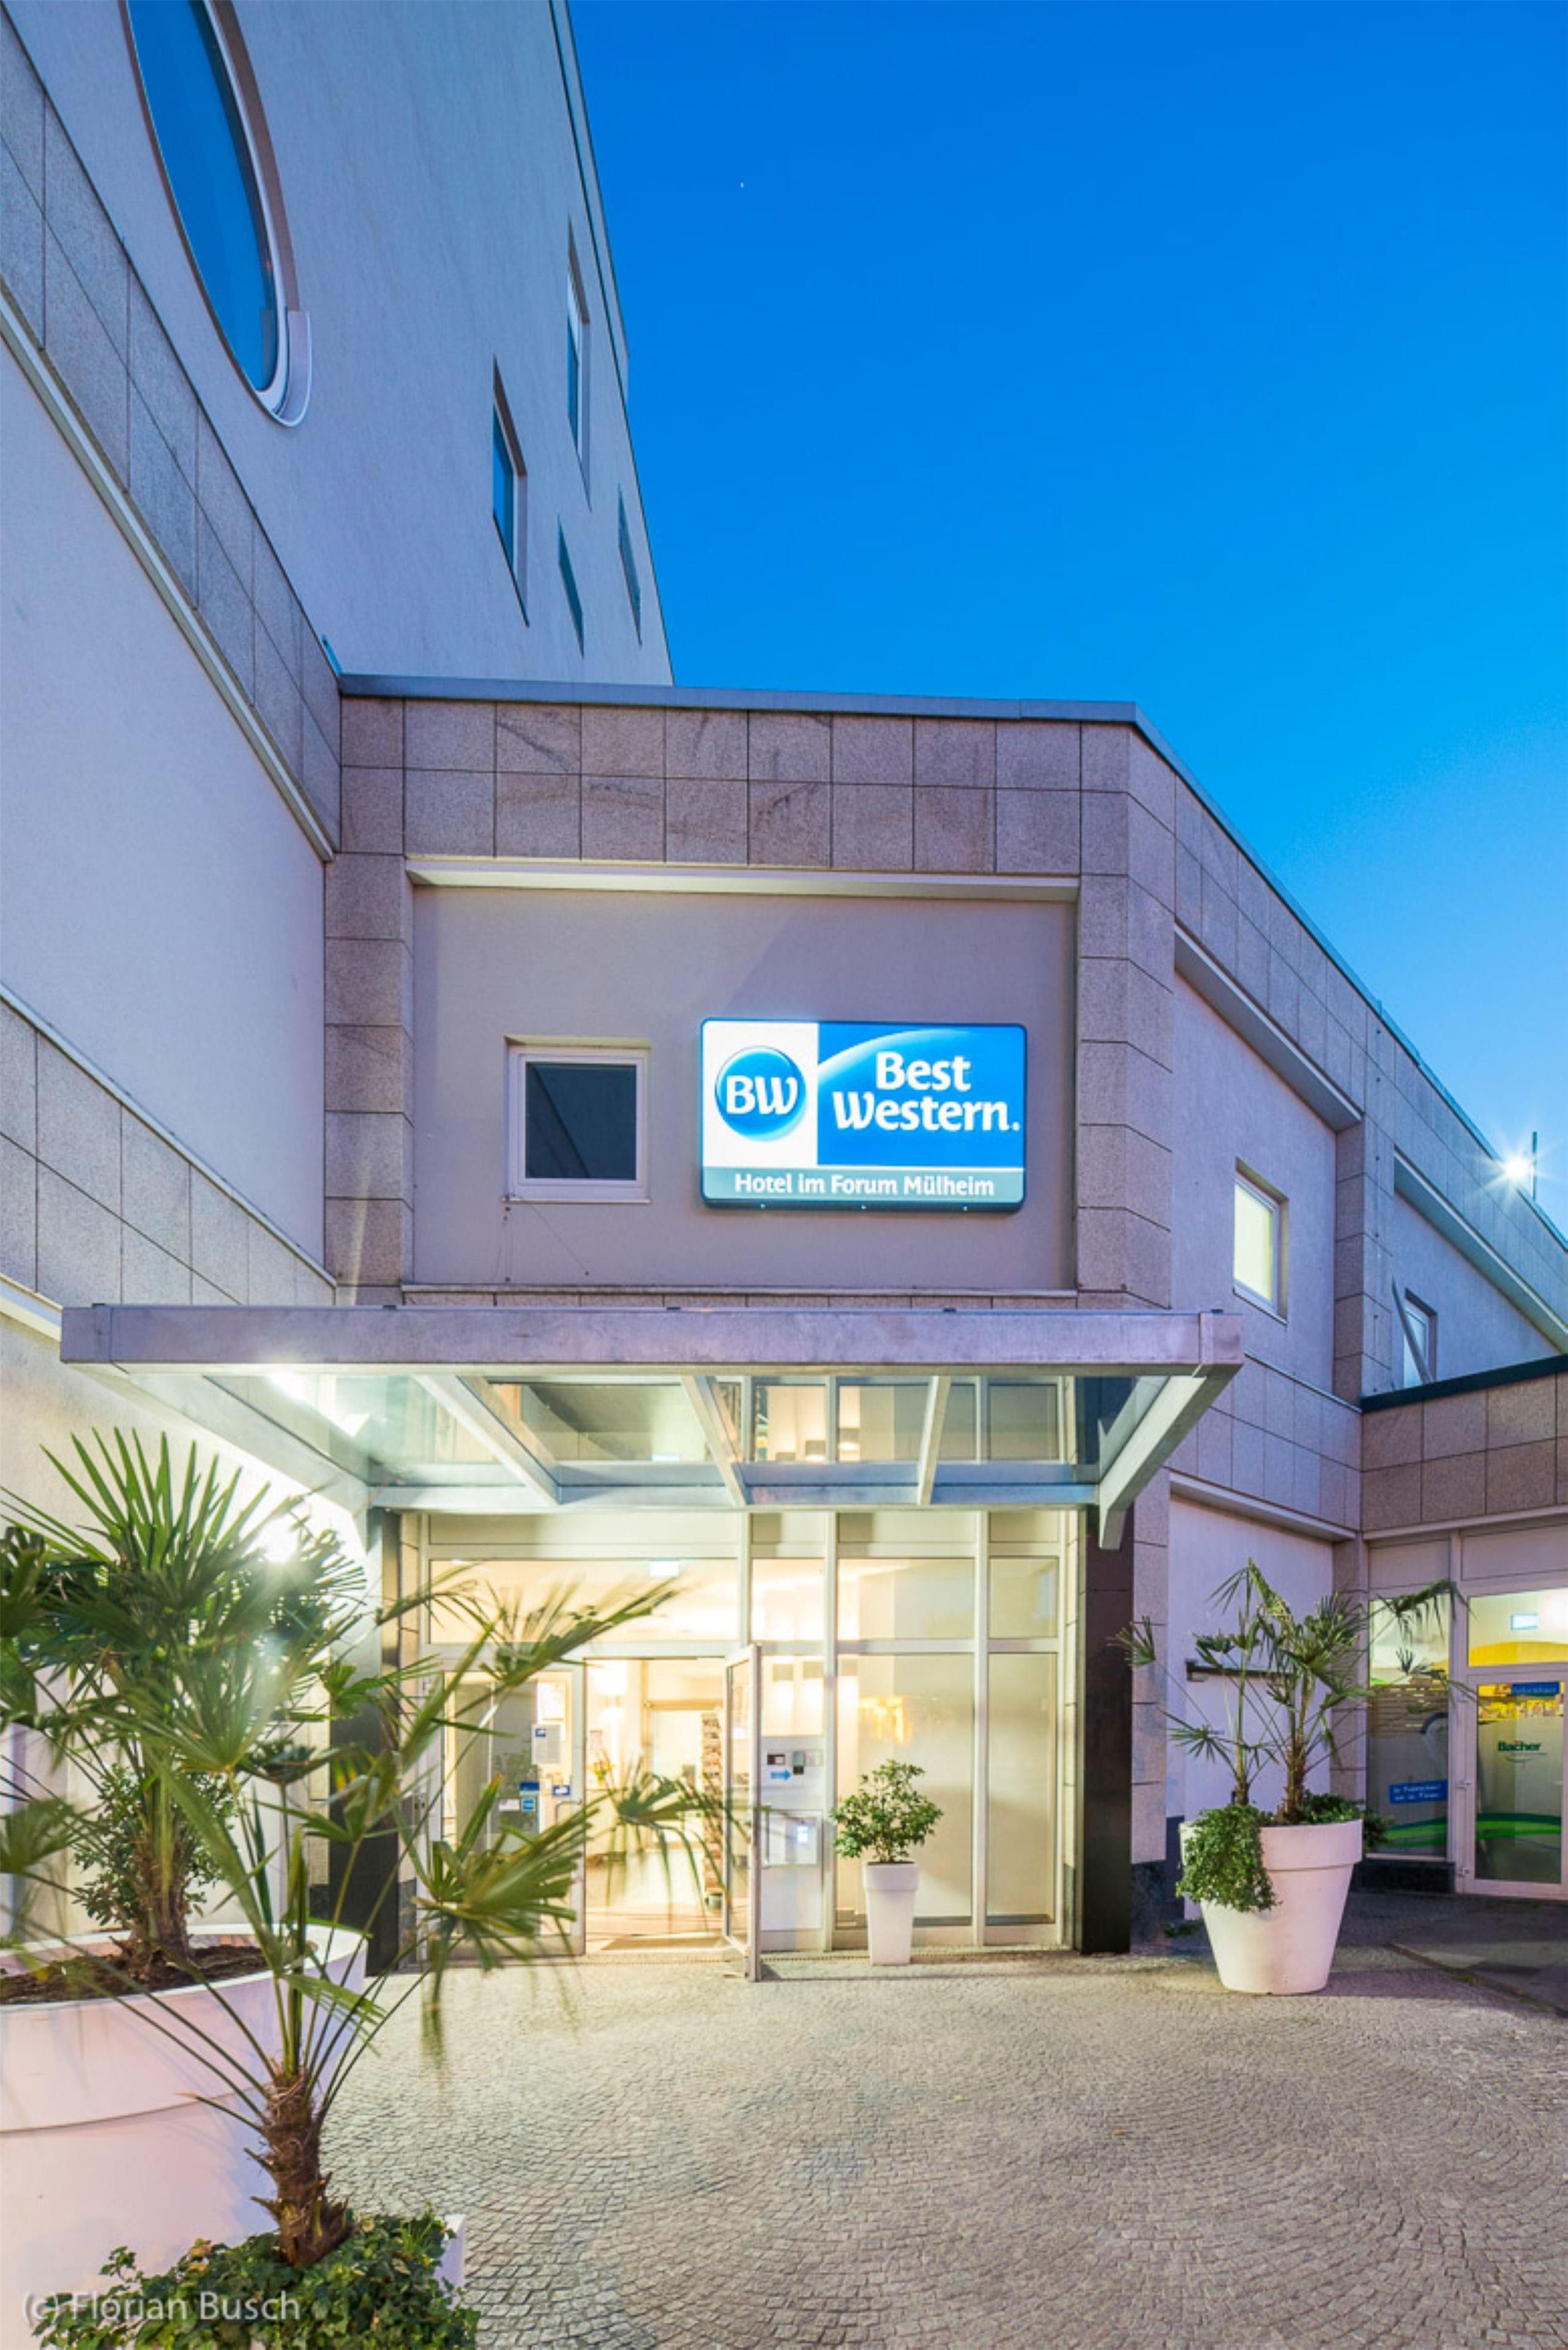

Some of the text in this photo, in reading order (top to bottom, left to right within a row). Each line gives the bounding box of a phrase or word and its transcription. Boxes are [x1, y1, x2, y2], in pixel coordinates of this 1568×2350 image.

[875, 1051, 971, 1091] Best
[725, 1075, 797, 1114] BW
[734, 1173, 995, 1197] Hotel im Forum Mülheim
